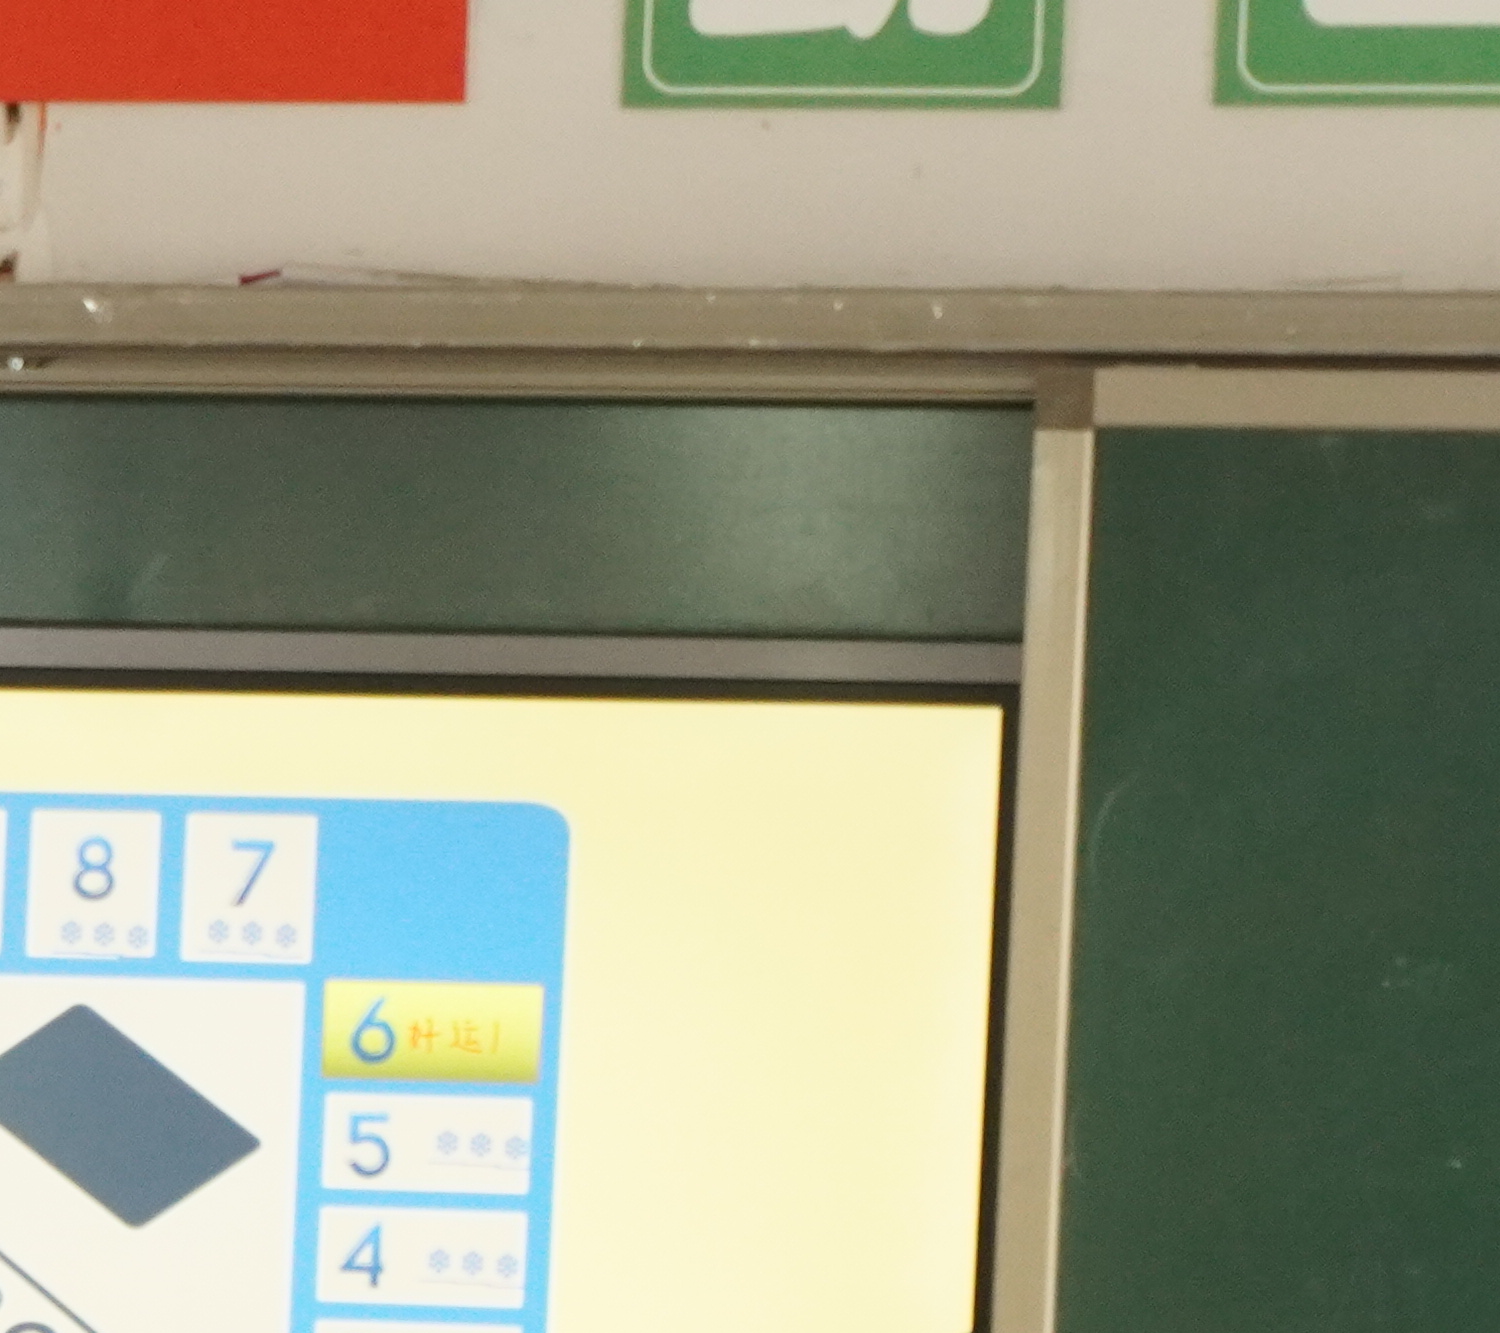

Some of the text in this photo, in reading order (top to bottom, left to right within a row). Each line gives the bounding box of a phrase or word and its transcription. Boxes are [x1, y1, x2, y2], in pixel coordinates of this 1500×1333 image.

[73, 836, 115, 900] 8
[233, 839, 275, 905] 7
[350, 1000, 396, 1066] 6
[349, 1113, 390, 1178] 5
[341, 1225, 383, 1286] 4
